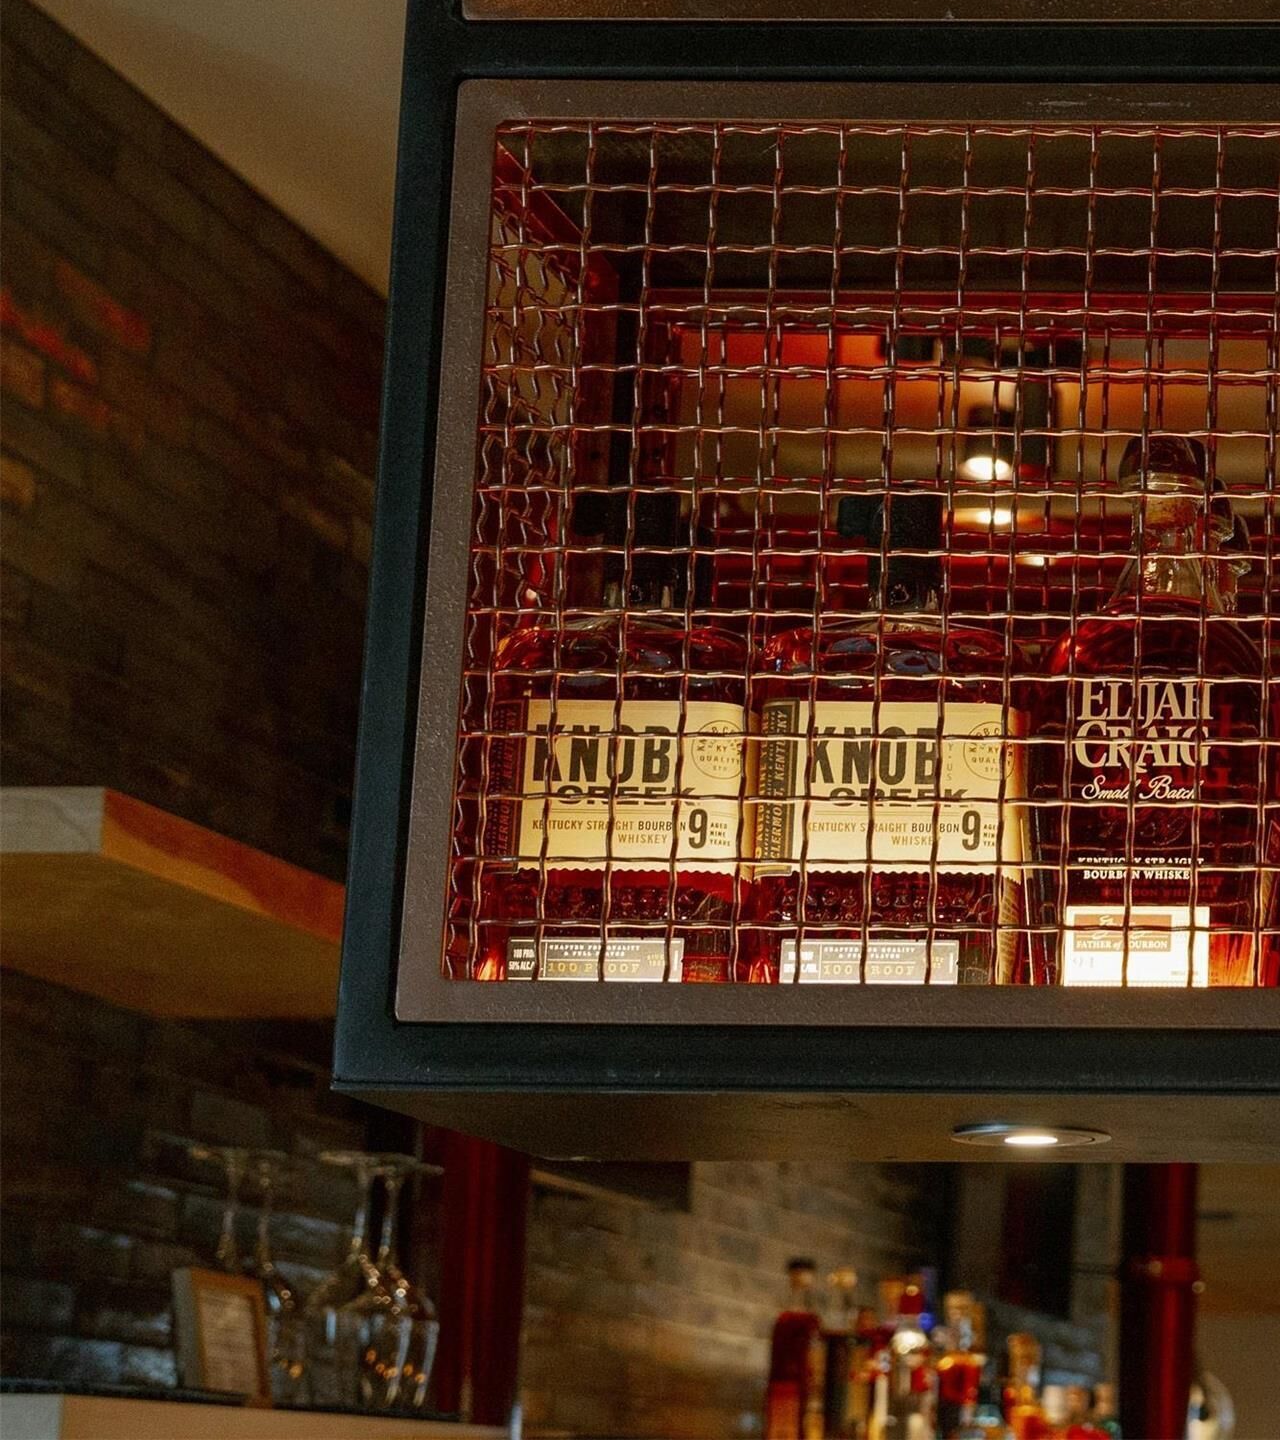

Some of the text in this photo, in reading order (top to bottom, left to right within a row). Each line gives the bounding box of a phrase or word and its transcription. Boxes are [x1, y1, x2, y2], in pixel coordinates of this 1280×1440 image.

[1074, 720, 1211, 773] CRAIG
[533, 723, 671, 784] KNOB
[811, 725, 937, 786] KNOB
[1082, 775, 1138, 800] Small
[532, 820, 687, 832] KETUCKY STRAGHT BOURBN
[688, 808, 709, 849] 9
[860, 822, 908, 833] SRAIGHT
[911, 822, 960, 834] BOUBON
[962, 810, 981, 851] 9
[617, 833, 668, 845] WHISKEY
[1143, 870, 1191, 880] WHISKE
[1076, 941, 1111, 949] FATHER
[1128, 940, 1168, 949] OURBON
[548, 962, 640, 974] 100 POOF
[823, 964, 915, 976] 100 ROOF
